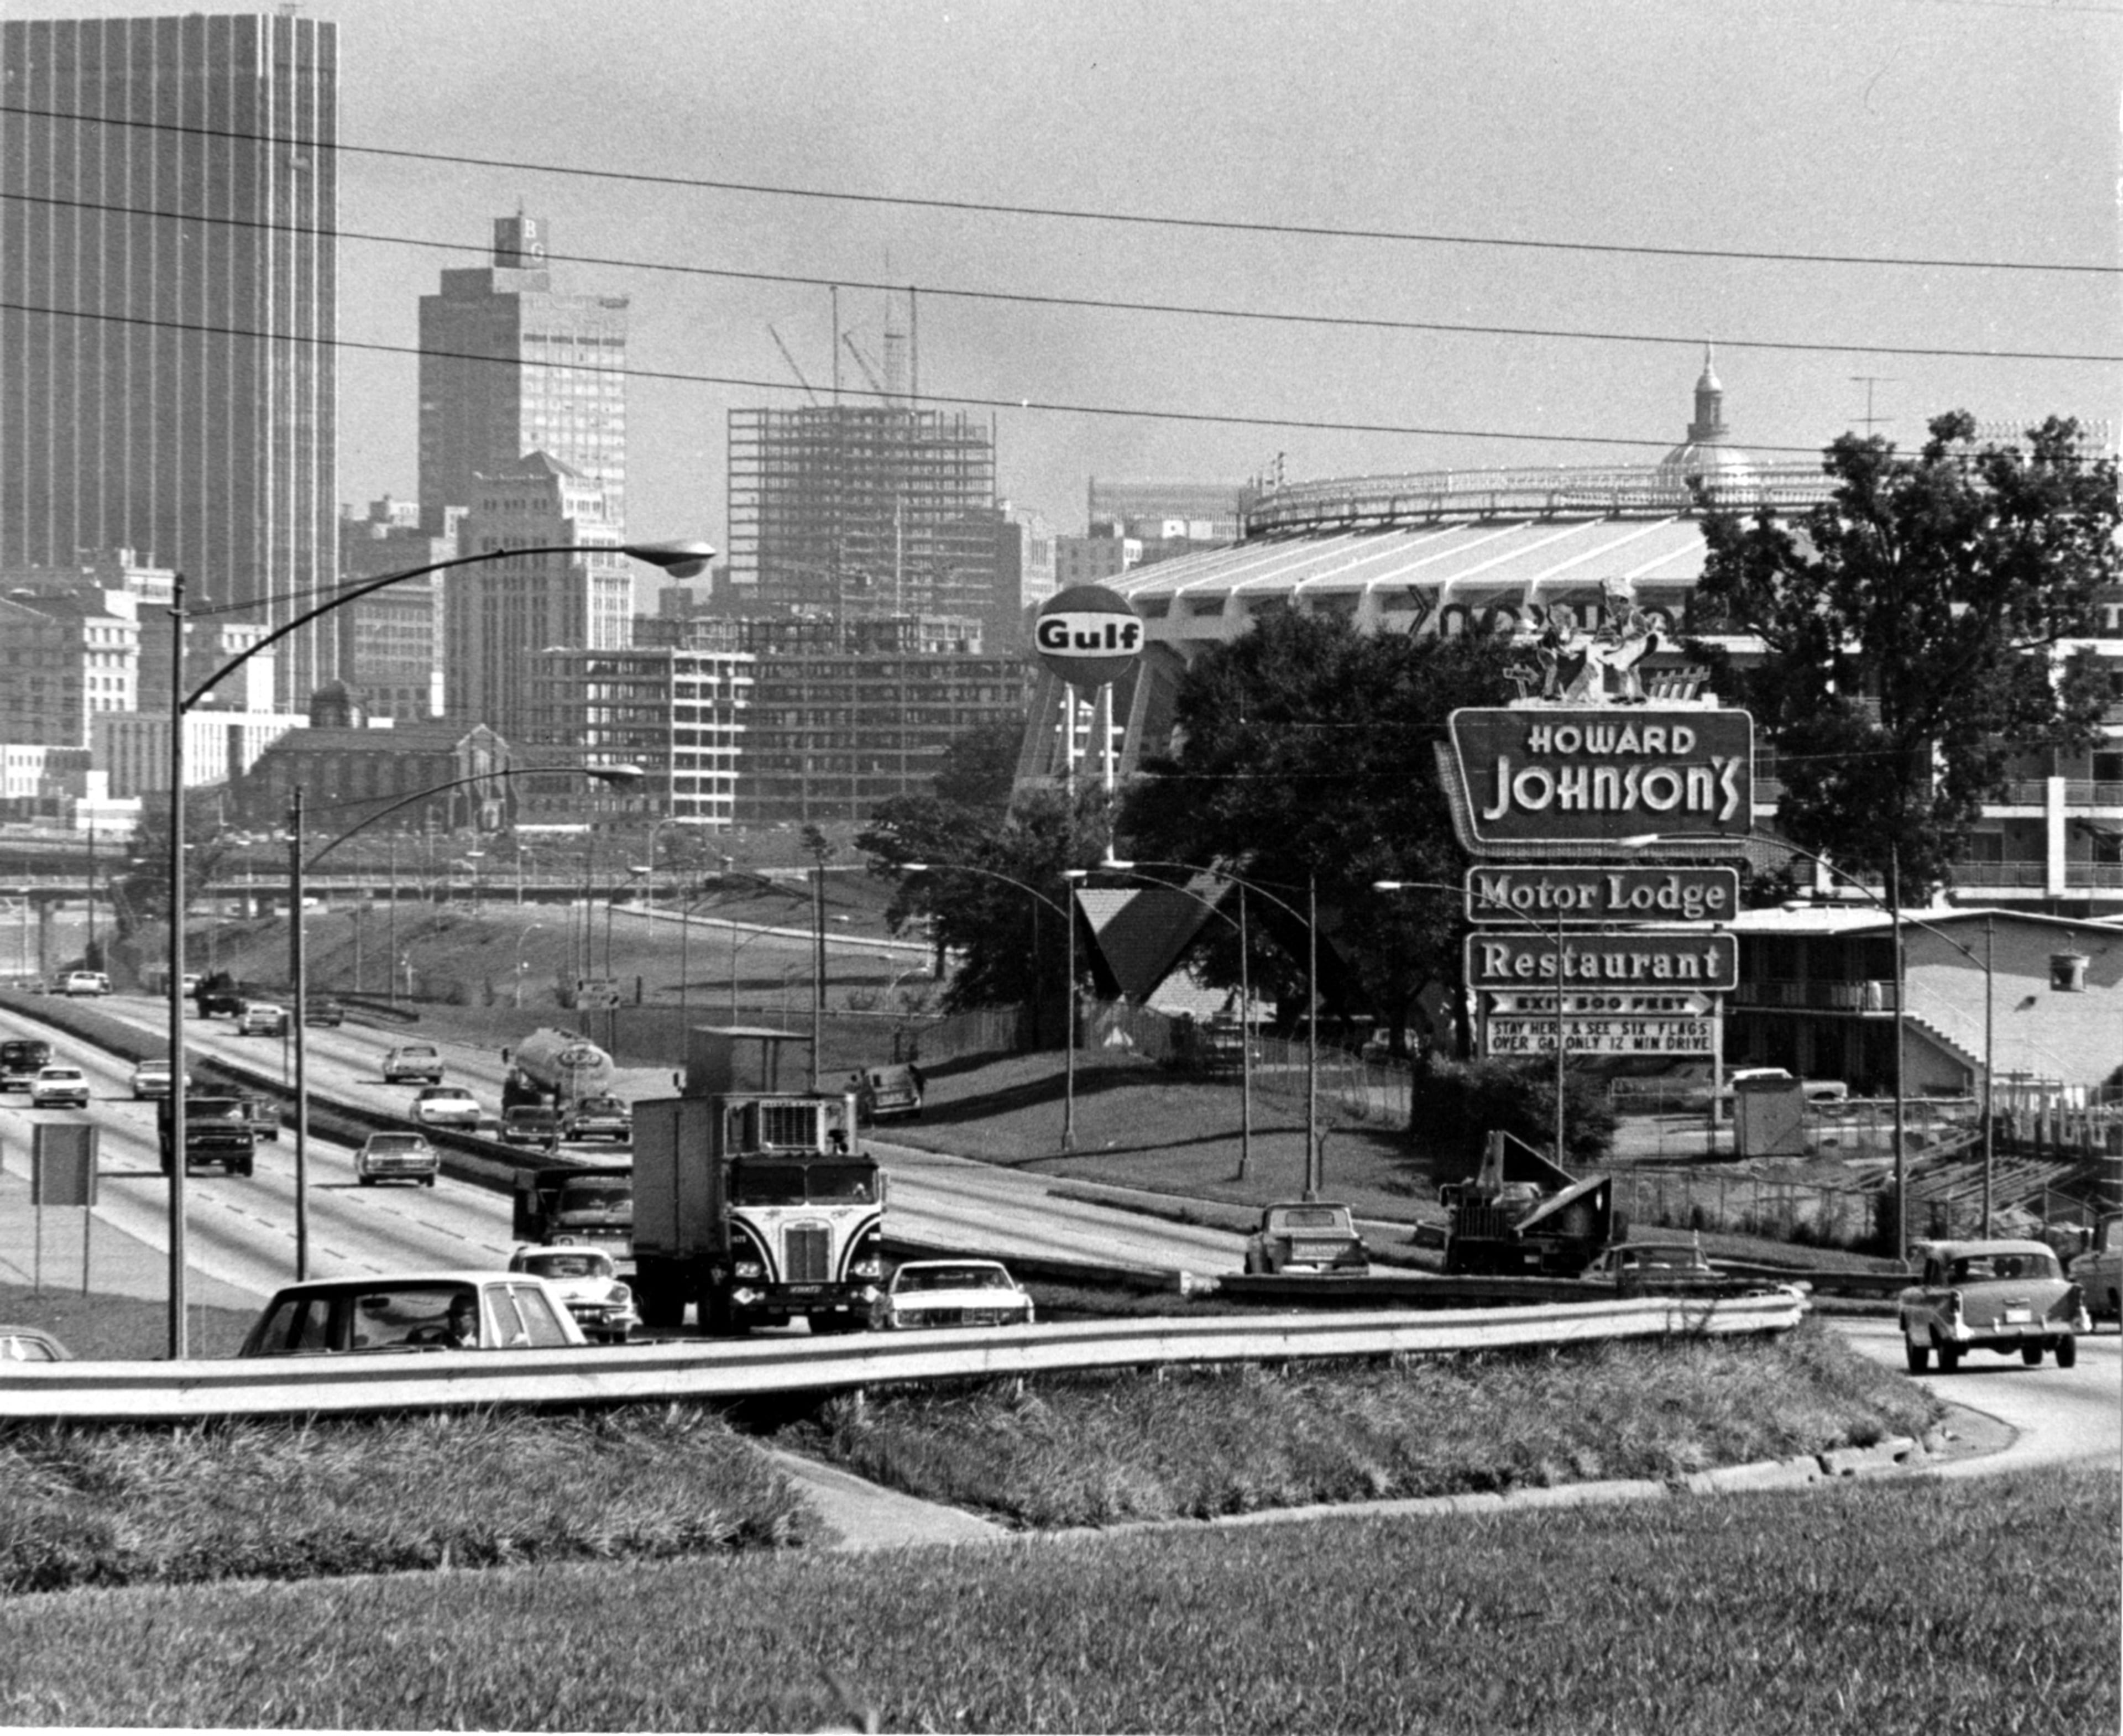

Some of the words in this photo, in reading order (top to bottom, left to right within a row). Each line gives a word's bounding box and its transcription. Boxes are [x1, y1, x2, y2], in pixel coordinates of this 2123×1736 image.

[524, 219, 537, 238] B
[1038, 619, 1139, 649] Gulf
[1528, 725, 1696, 754] HOWARD
[1477, 874, 1598, 909] Motor
[1607, 874, 1726, 919] Lodge
[1481, 942, 1720, 978] Restaurant
[1576, 996, 1622, 1010] 500
[1632, 997, 1689, 1010] FEET
[1494, 1021, 1525, 1035] STAY
[1530, 1021, 1565, 1035] HER
[1586, 1021, 1610, 1035] SEE
[1622, 1022, 1646, 1035] SIX
[1658, 1022, 1707, 1036] FLAGS
[1493, 1036, 1529, 1049] OVER
[1565, 1036, 1601, 1049] ONLY
[1666, 1037, 1709, 1050] DRIVE
